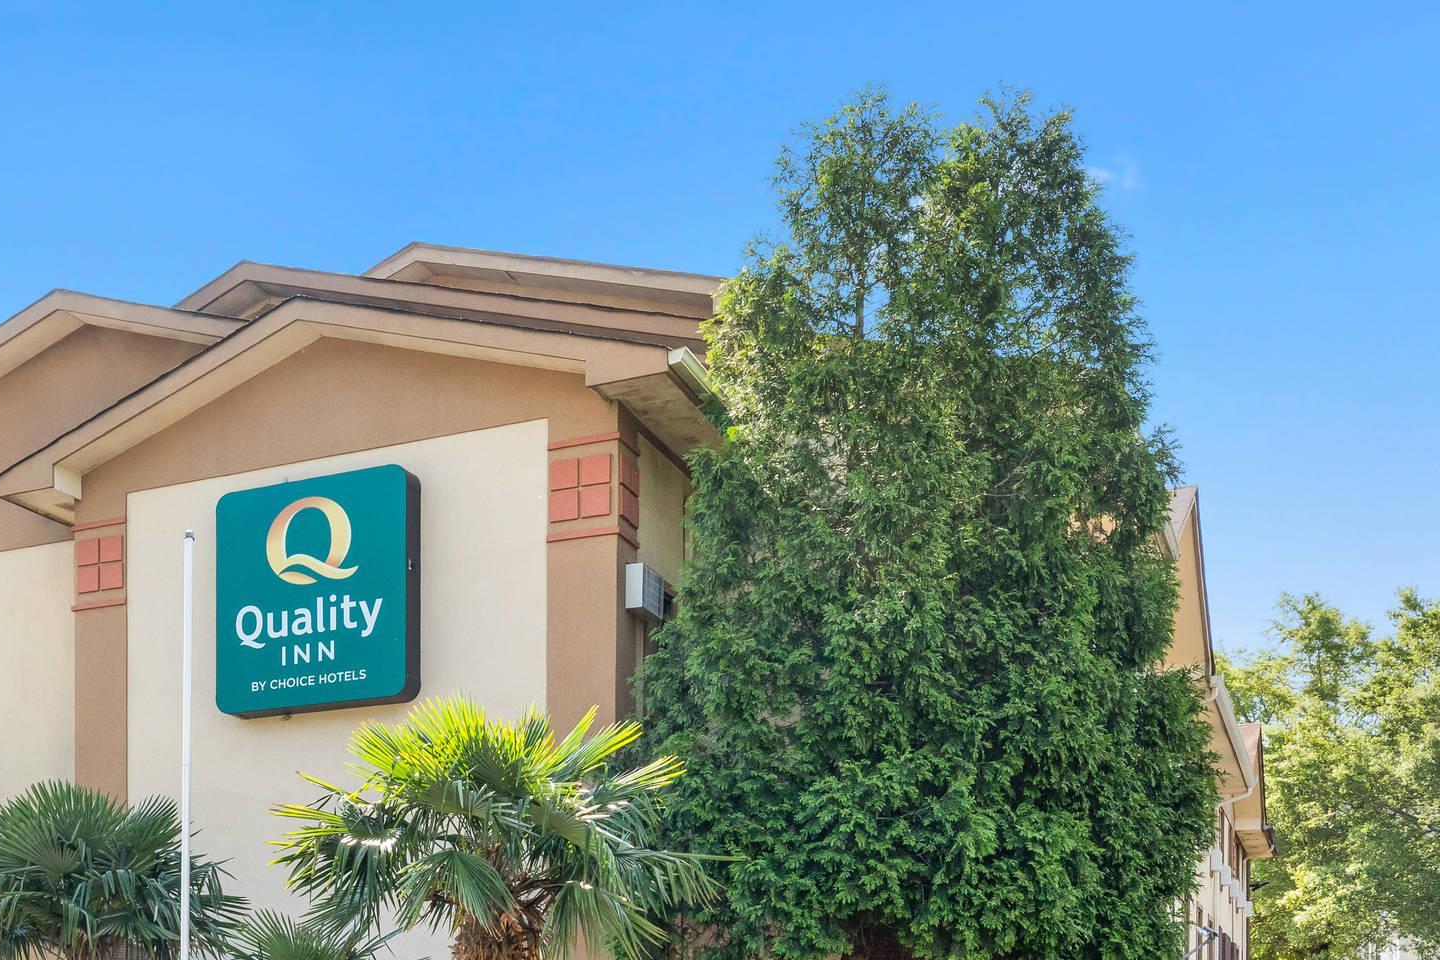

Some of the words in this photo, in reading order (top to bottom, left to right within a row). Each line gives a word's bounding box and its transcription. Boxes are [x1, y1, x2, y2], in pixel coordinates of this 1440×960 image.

[266, 496, 359, 585] Q
[235, 594, 383, 649] Quality
[281, 640, 335, 666] INN
[251, 681, 267, 692] BY
[269, 675, 316, 690] CHOICE
[318, 669, 367, 685] HOTELS
